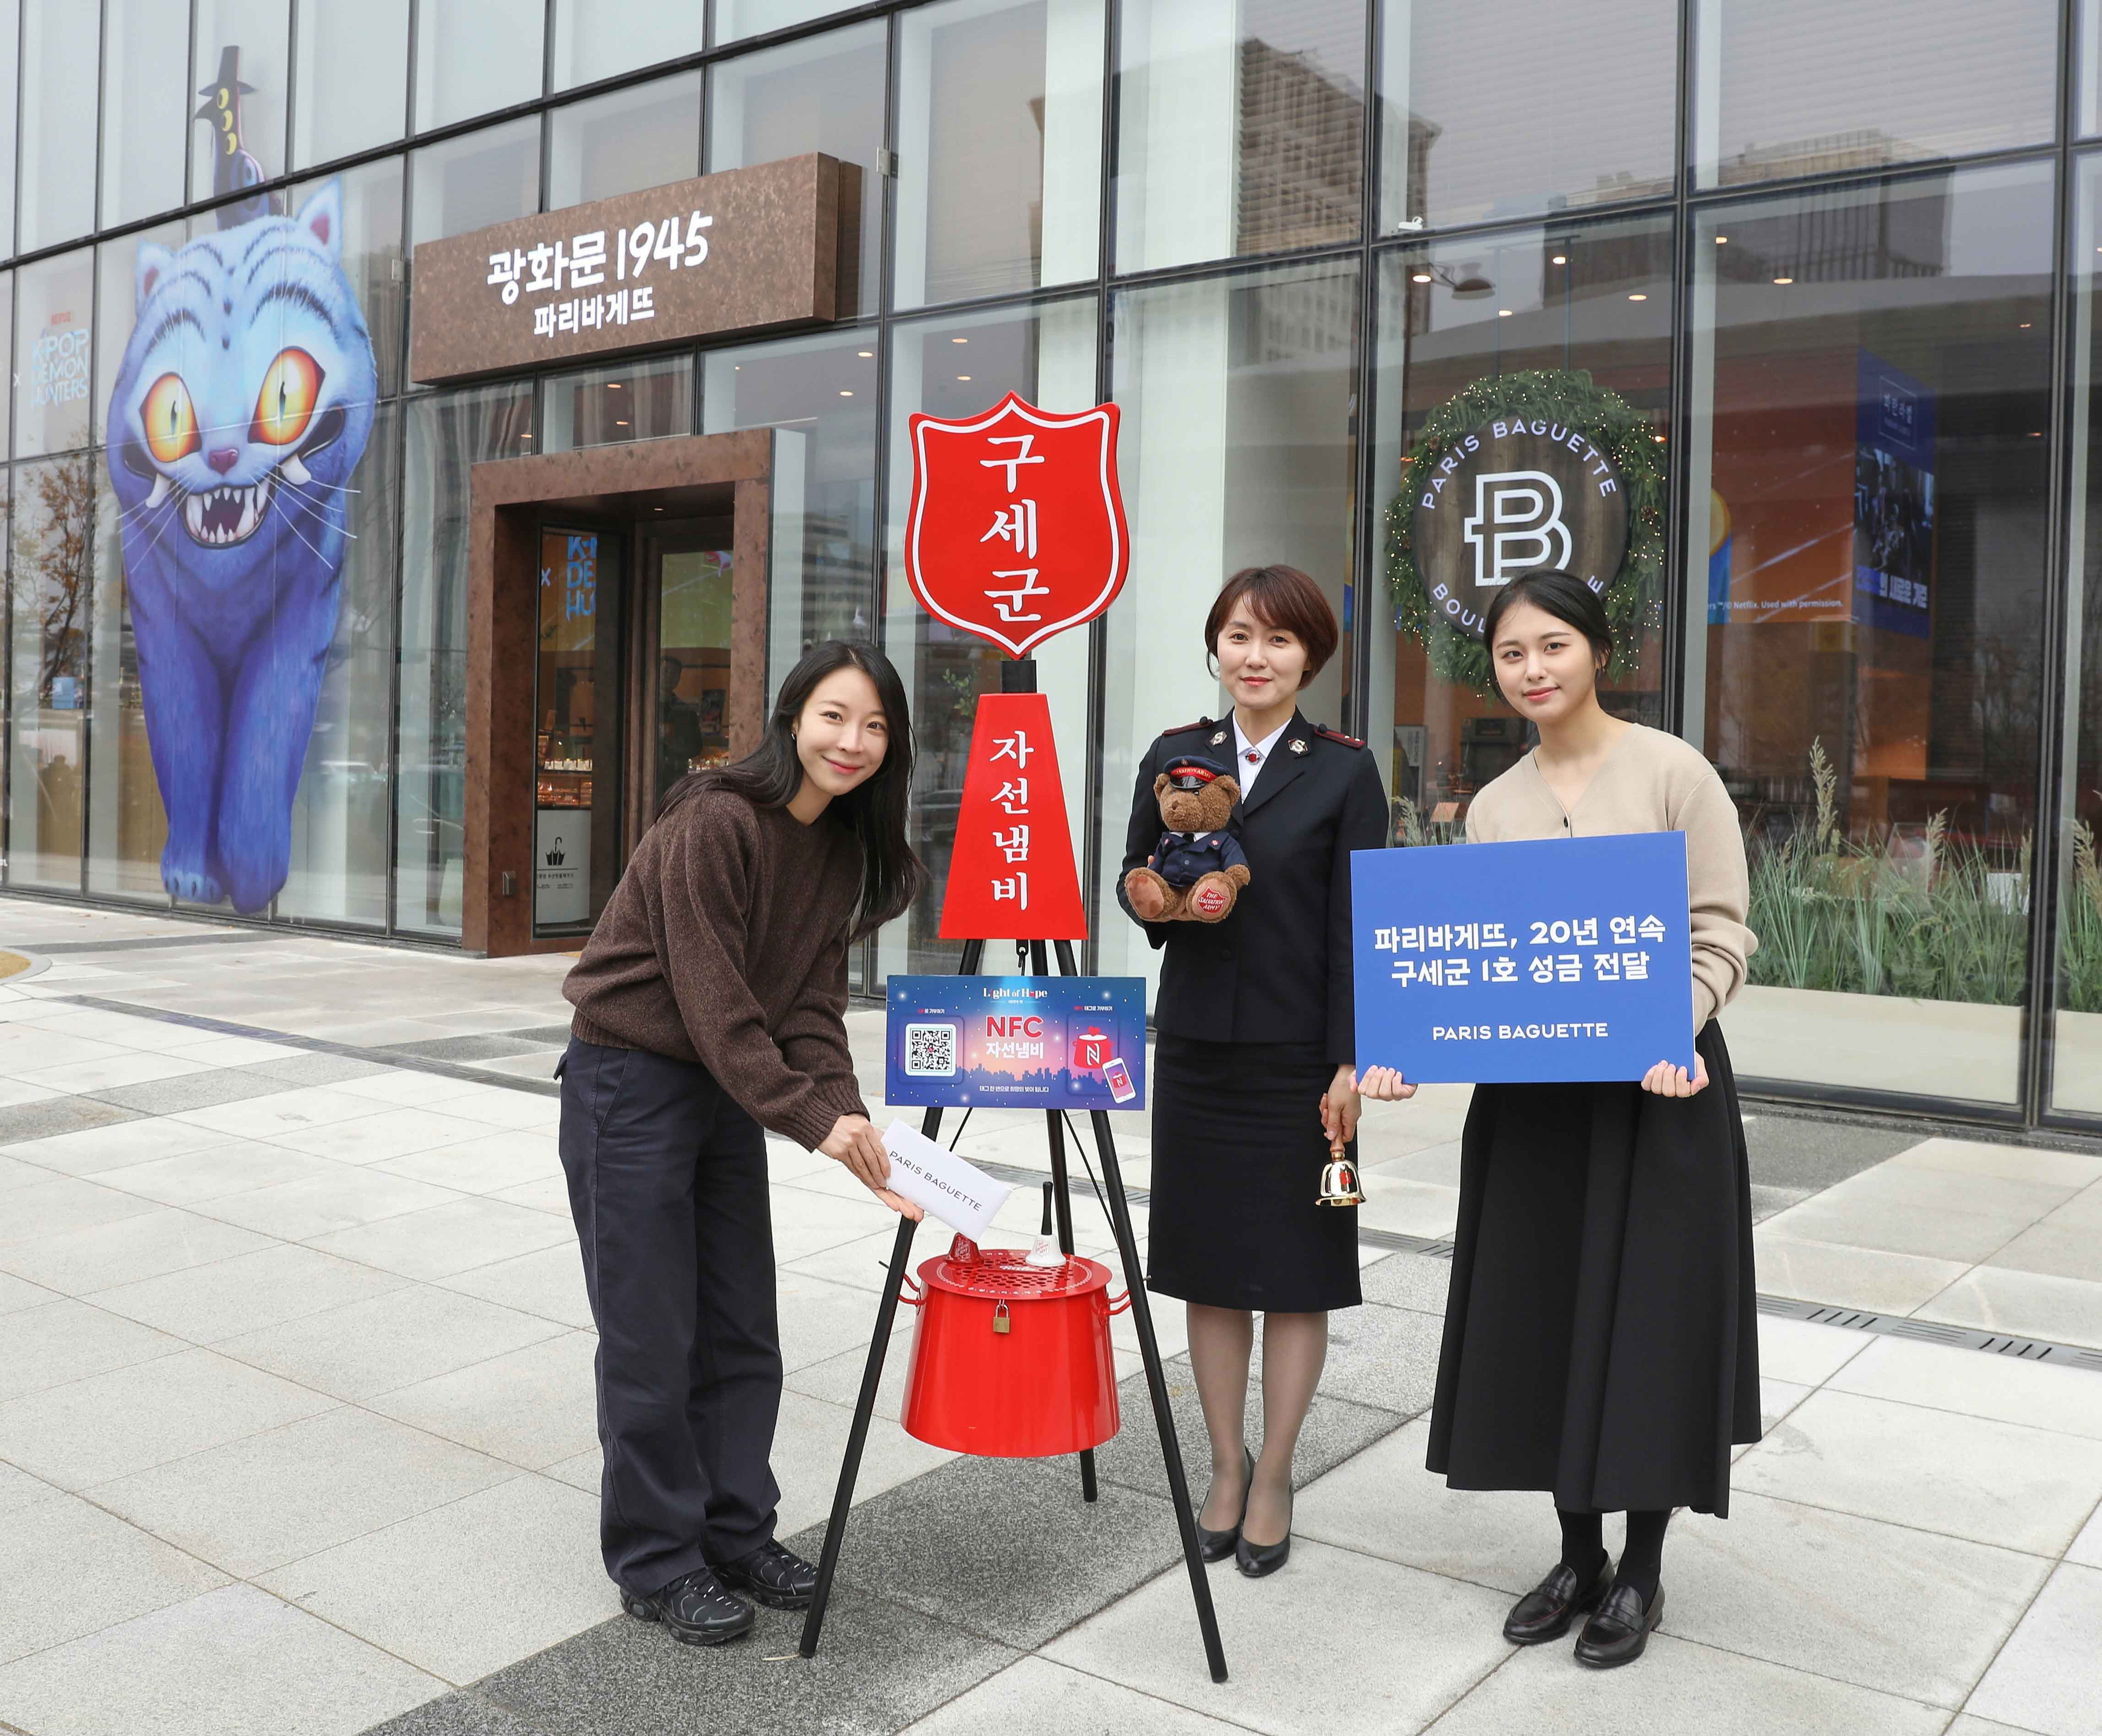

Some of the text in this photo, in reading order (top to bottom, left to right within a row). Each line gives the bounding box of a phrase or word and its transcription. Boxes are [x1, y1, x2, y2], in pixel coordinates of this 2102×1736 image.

[487, 210, 713, 305] 광화문 1945
[534, 286, 655, 338] 파리바게뜨
[1422, 419, 1616, 510] PARIS BAGUETTE
[980, 434, 1050, 622] 구세군
[566, 560, 596, 589] DE
[566, 590, 596, 622] HU
[1433, 583, 1485, 634] BOUL
[1781, 600, 1798, 608] with
[1798, 599, 1843, 609] permission.
[989, 730, 1035, 910] 자선냄비
[1199, 897, 1225, 905] SALVATION
[1374, 914, 1666, 953] 파리바게뜨, 20년 연속
[1391, 951, 1650, 988] 구세군 1호 성금 전달
[986, 1016, 1043, 1039] NFC
[1433, 1023, 1608, 1041] PARIS BAGUETTE
[986, 1041, 1044, 1059] 자선냄비
[890, 1151, 982, 1211] PARIS BAGUETTE
